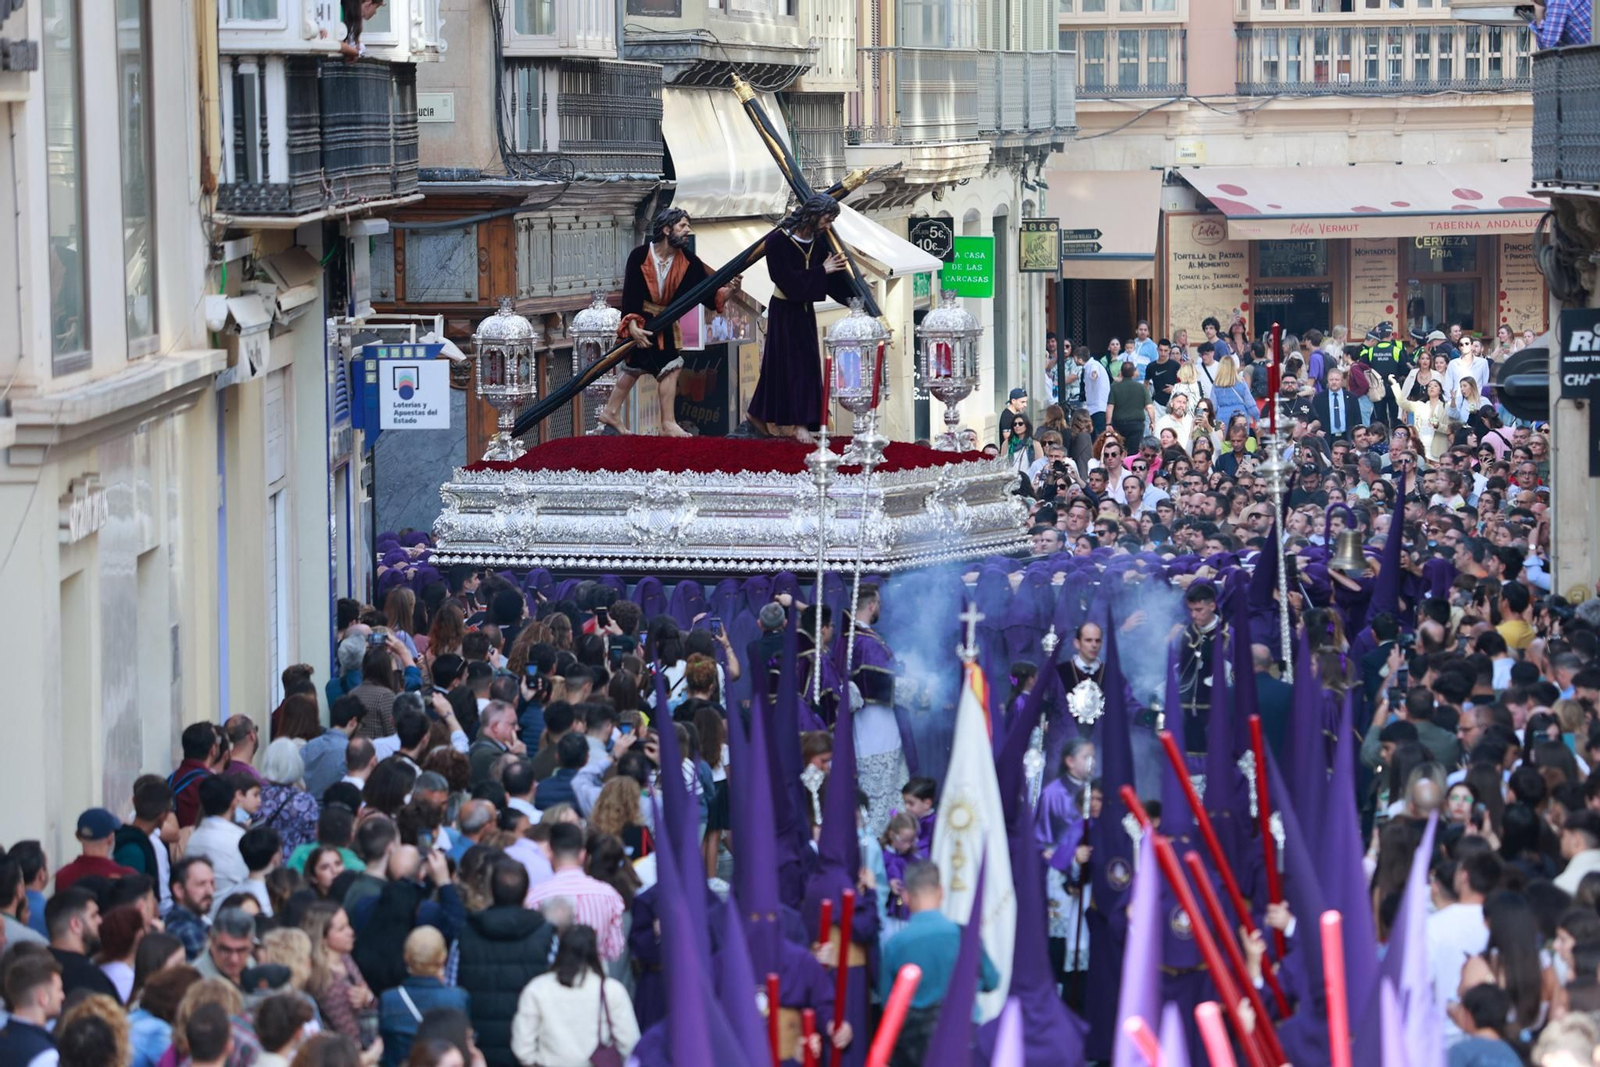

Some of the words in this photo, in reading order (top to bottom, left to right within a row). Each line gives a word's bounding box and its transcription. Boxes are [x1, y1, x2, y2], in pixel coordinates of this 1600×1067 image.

[417, 107, 434, 117] UCÍA
[1318, 222, 1360, 235] VERMUT
[1428, 220, 1481, 231] TABERNA
[1269, 241, 1315, 252] VERMUT
[1415, 236, 1468, 249] CERVEZA
[1504, 242, 1534, 253] PINCHO
[1173, 253, 1206, 262] TORTILLA
[1208, 253, 1216, 261] DE
[1219, 251, 1244, 261] PATATA
[1354, 248, 1397, 257] MONTADITOS
[951, 263, 963, 271] DE
[1188, 261, 1196, 269] AL
[1197, 261, 1230, 269] MOMENTO
[945, 275, 989, 283] CARCASAS
[1178, 273, 1200, 281] TOMATE
[1569, 323, 1600, 352] Ri
[427, 408, 437, 416] del
[680, 401, 720, 425] Frappé
